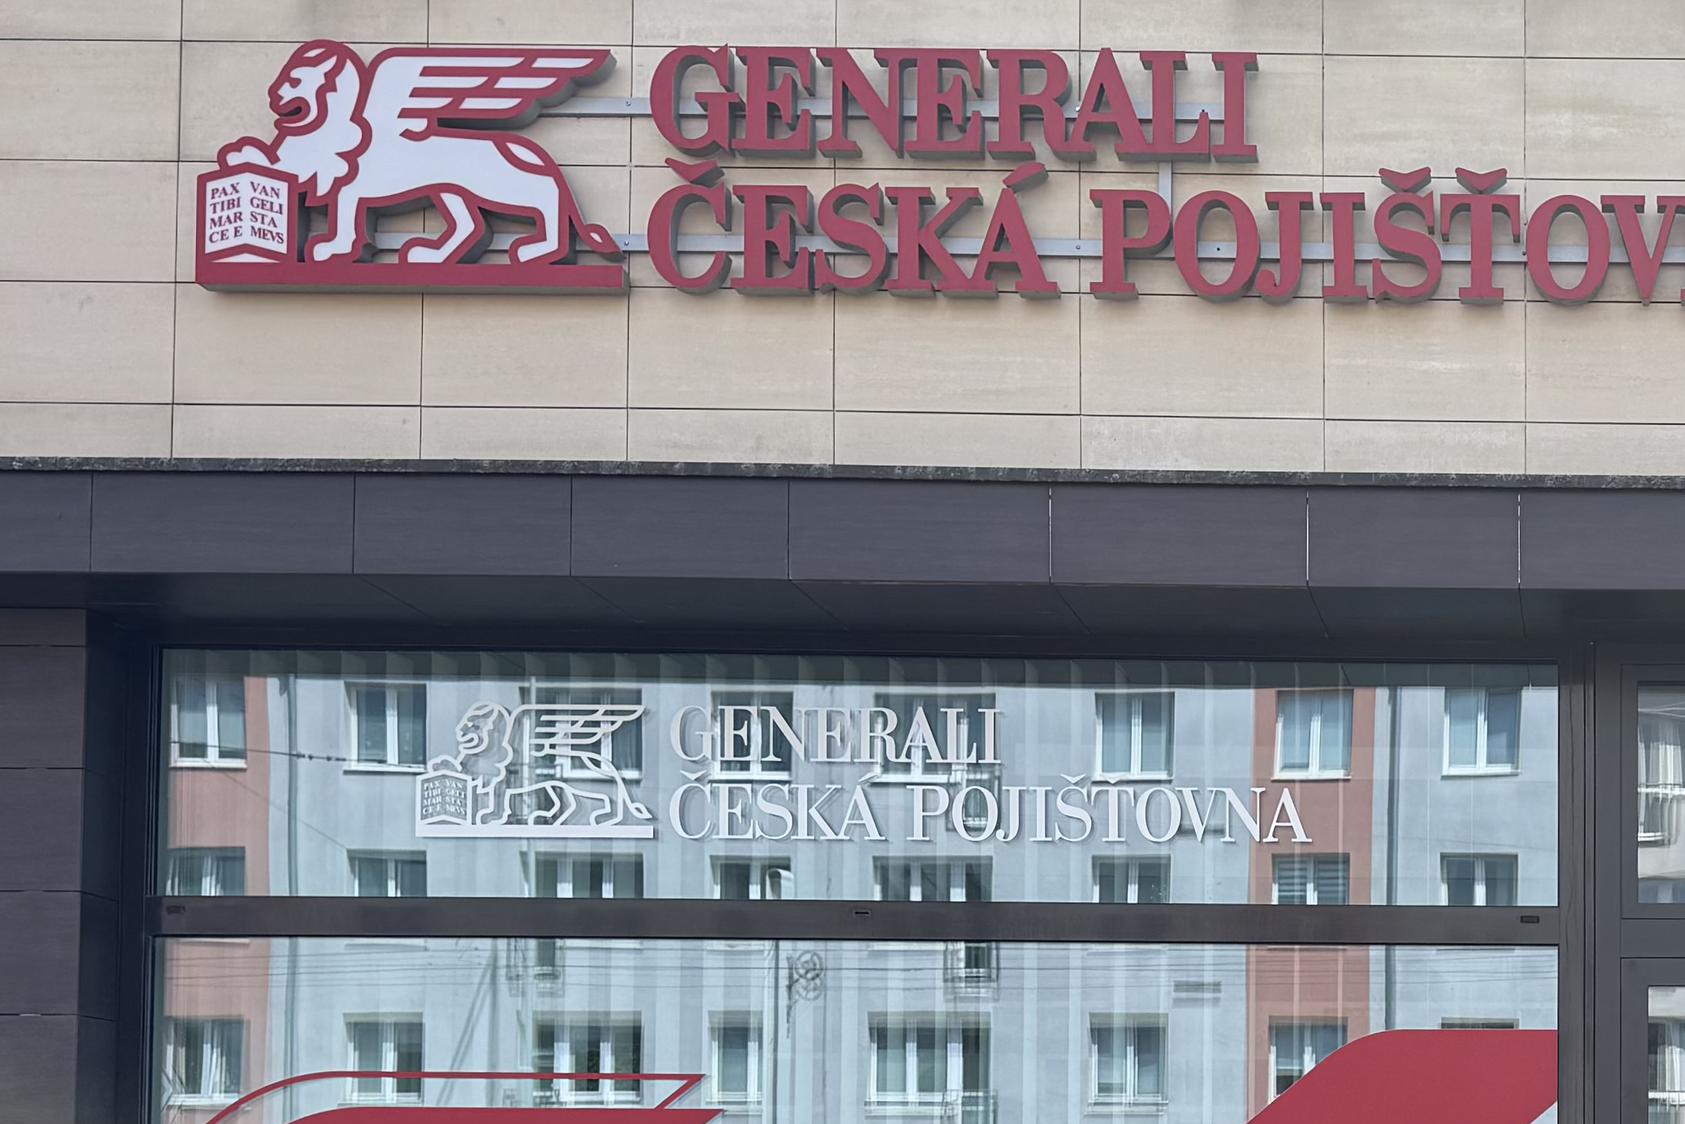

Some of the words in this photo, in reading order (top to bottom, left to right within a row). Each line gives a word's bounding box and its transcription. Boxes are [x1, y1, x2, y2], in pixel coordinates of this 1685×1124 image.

[649, 44, 1258, 163] GENERALI
[211, 182, 240, 200] PAX
[250, 181, 280, 199] VAN
[210, 196, 241, 214] TIBI
[250, 197, 283, 215] GELI
[210, 211, 243, 230] MAR
[250, 211, 278, 228] STA
[647, 158, 1060, 300] ČESKÁ
[670, 705, 1001, 765] GENERALI
[669, 770, 887, 841] ČESKÁ
[906, 773, 1313, 843] POJIŠŤOVNA
